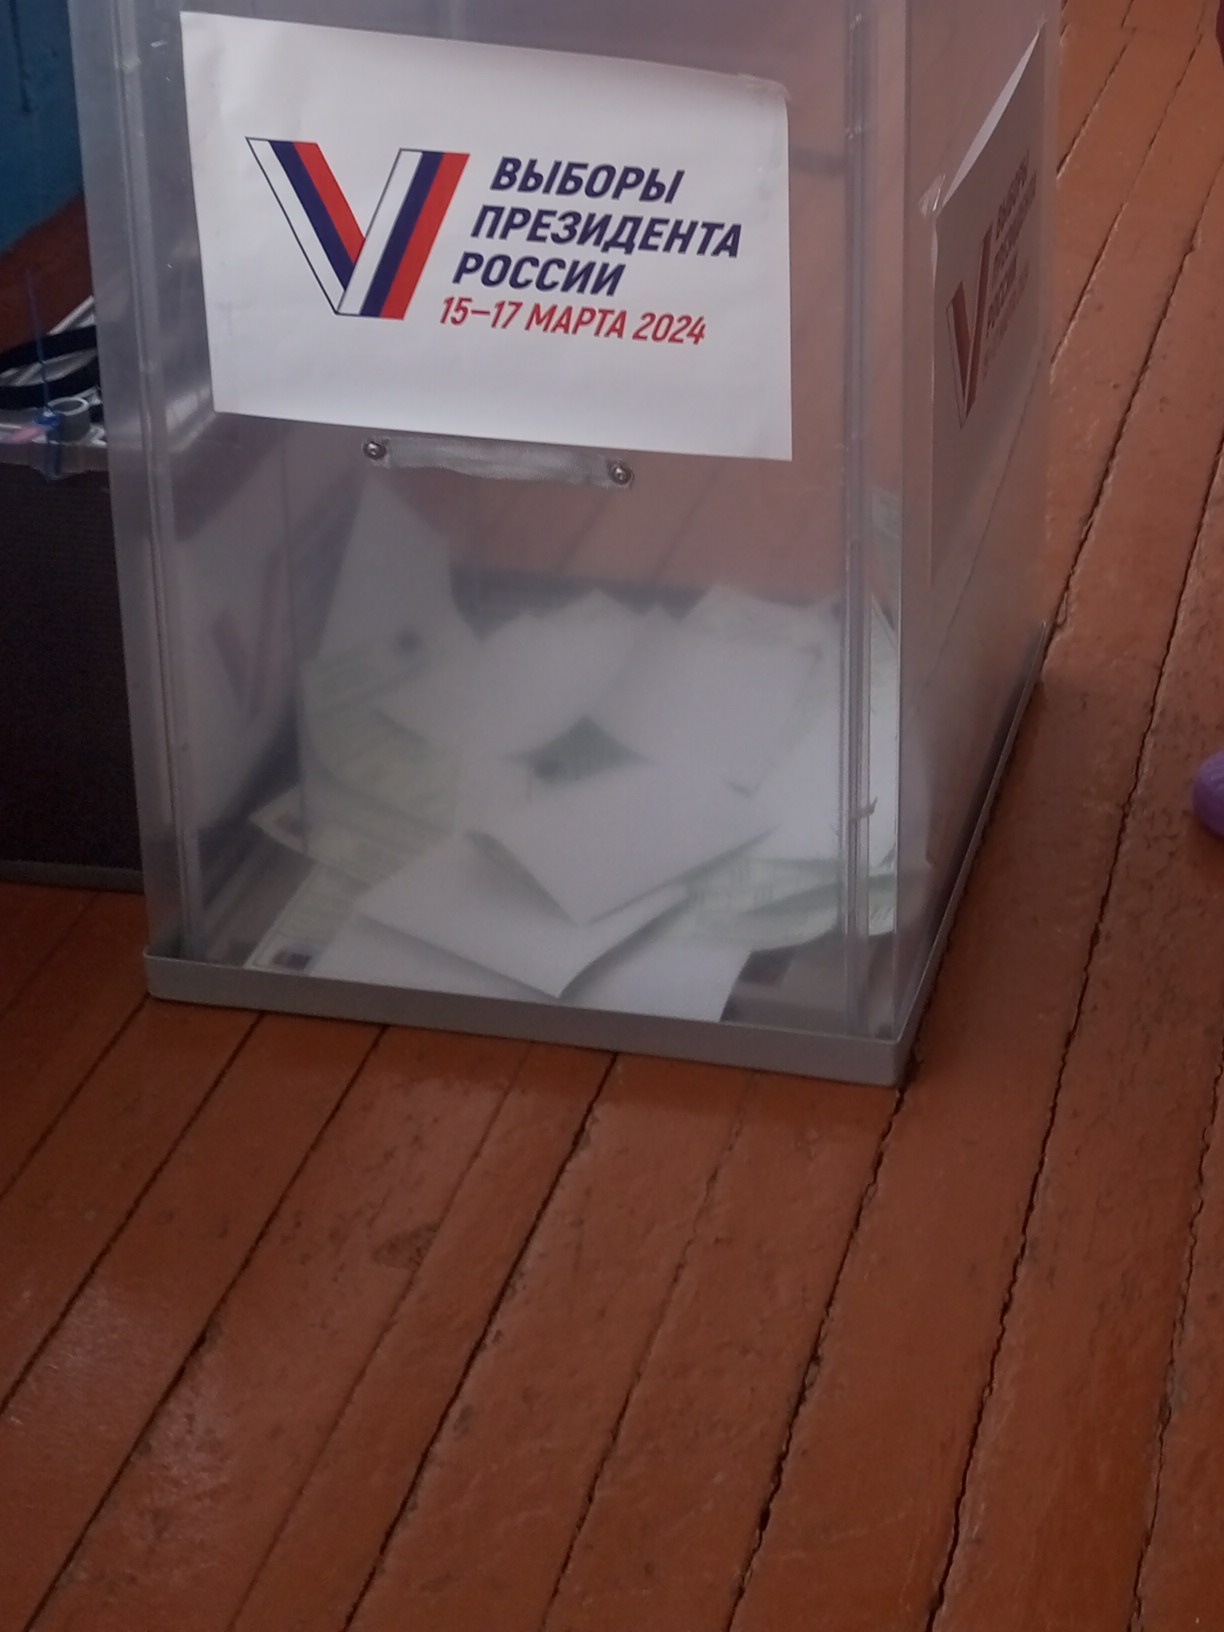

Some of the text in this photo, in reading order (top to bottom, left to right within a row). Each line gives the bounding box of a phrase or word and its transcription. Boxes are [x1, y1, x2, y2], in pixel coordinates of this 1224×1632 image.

[489, 156, 685, 203] ВЫБОРЫ
[470, 204, 742, 258] ПРЕЗИДЕНТА
[452, 251, 626, 297] РОССИИ
[524, 302, 627, 339] МАРТА
[632, 312, 706, 345] 2024
